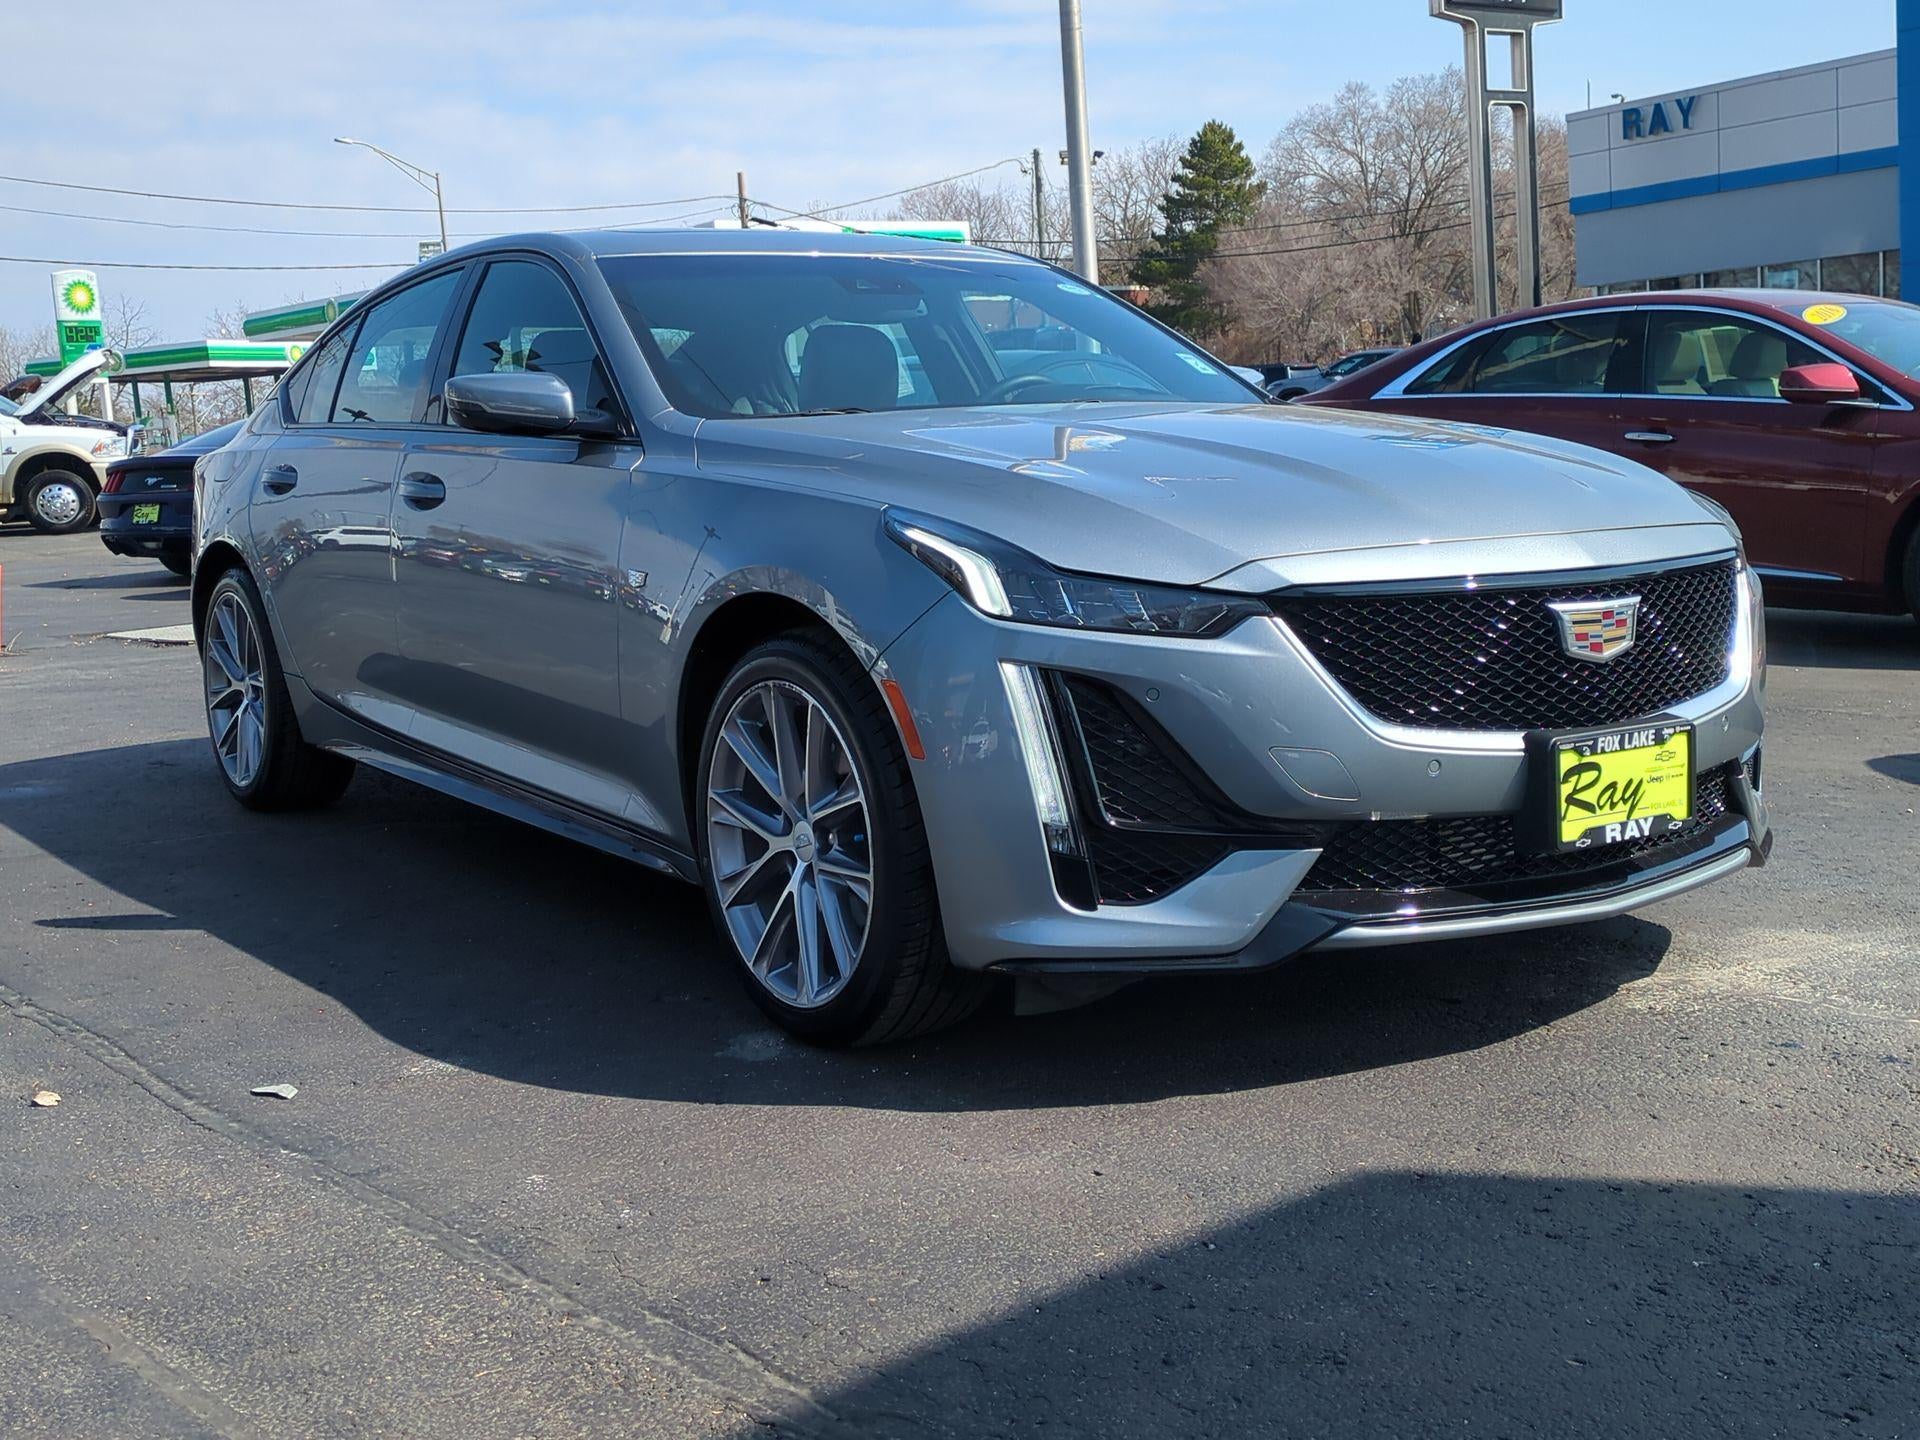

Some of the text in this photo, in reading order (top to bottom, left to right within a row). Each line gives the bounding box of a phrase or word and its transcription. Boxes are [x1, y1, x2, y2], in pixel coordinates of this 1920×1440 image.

[1622, 96, 1696, 140] RAY
[1597, 735, 1621, 753] FOX
[1624, 729, 1656, 749] LAKE
[1560, 761, 1646, 822] Ray
[1647, 774, 1665, 784] Jeep
[1605, 816, 1655, 844] RAY
